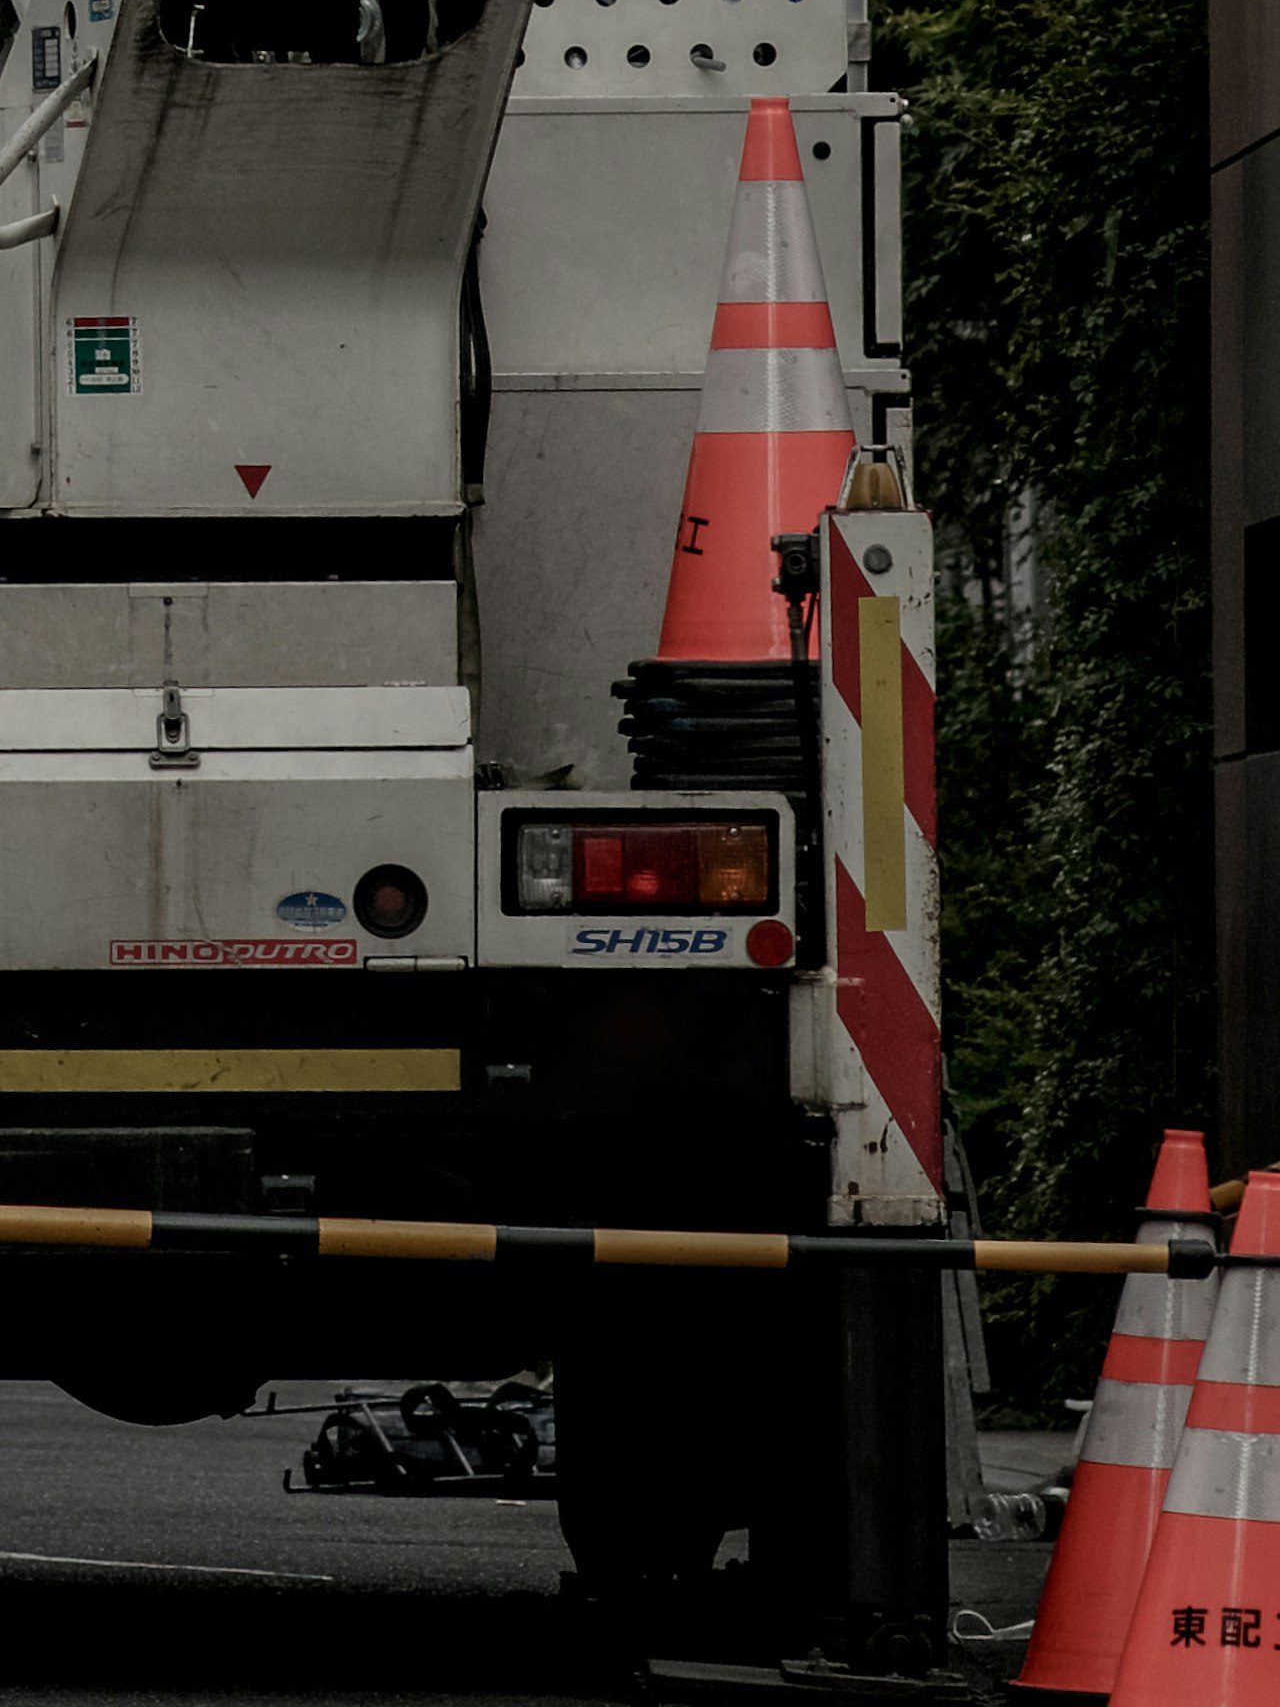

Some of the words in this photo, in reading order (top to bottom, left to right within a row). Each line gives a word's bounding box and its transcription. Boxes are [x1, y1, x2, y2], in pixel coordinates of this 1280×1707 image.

[116, 944, 221, 963] HINO
[572, 930, 727, 954] SH15B
[1171, 1606, 1280, 1650] 東配
